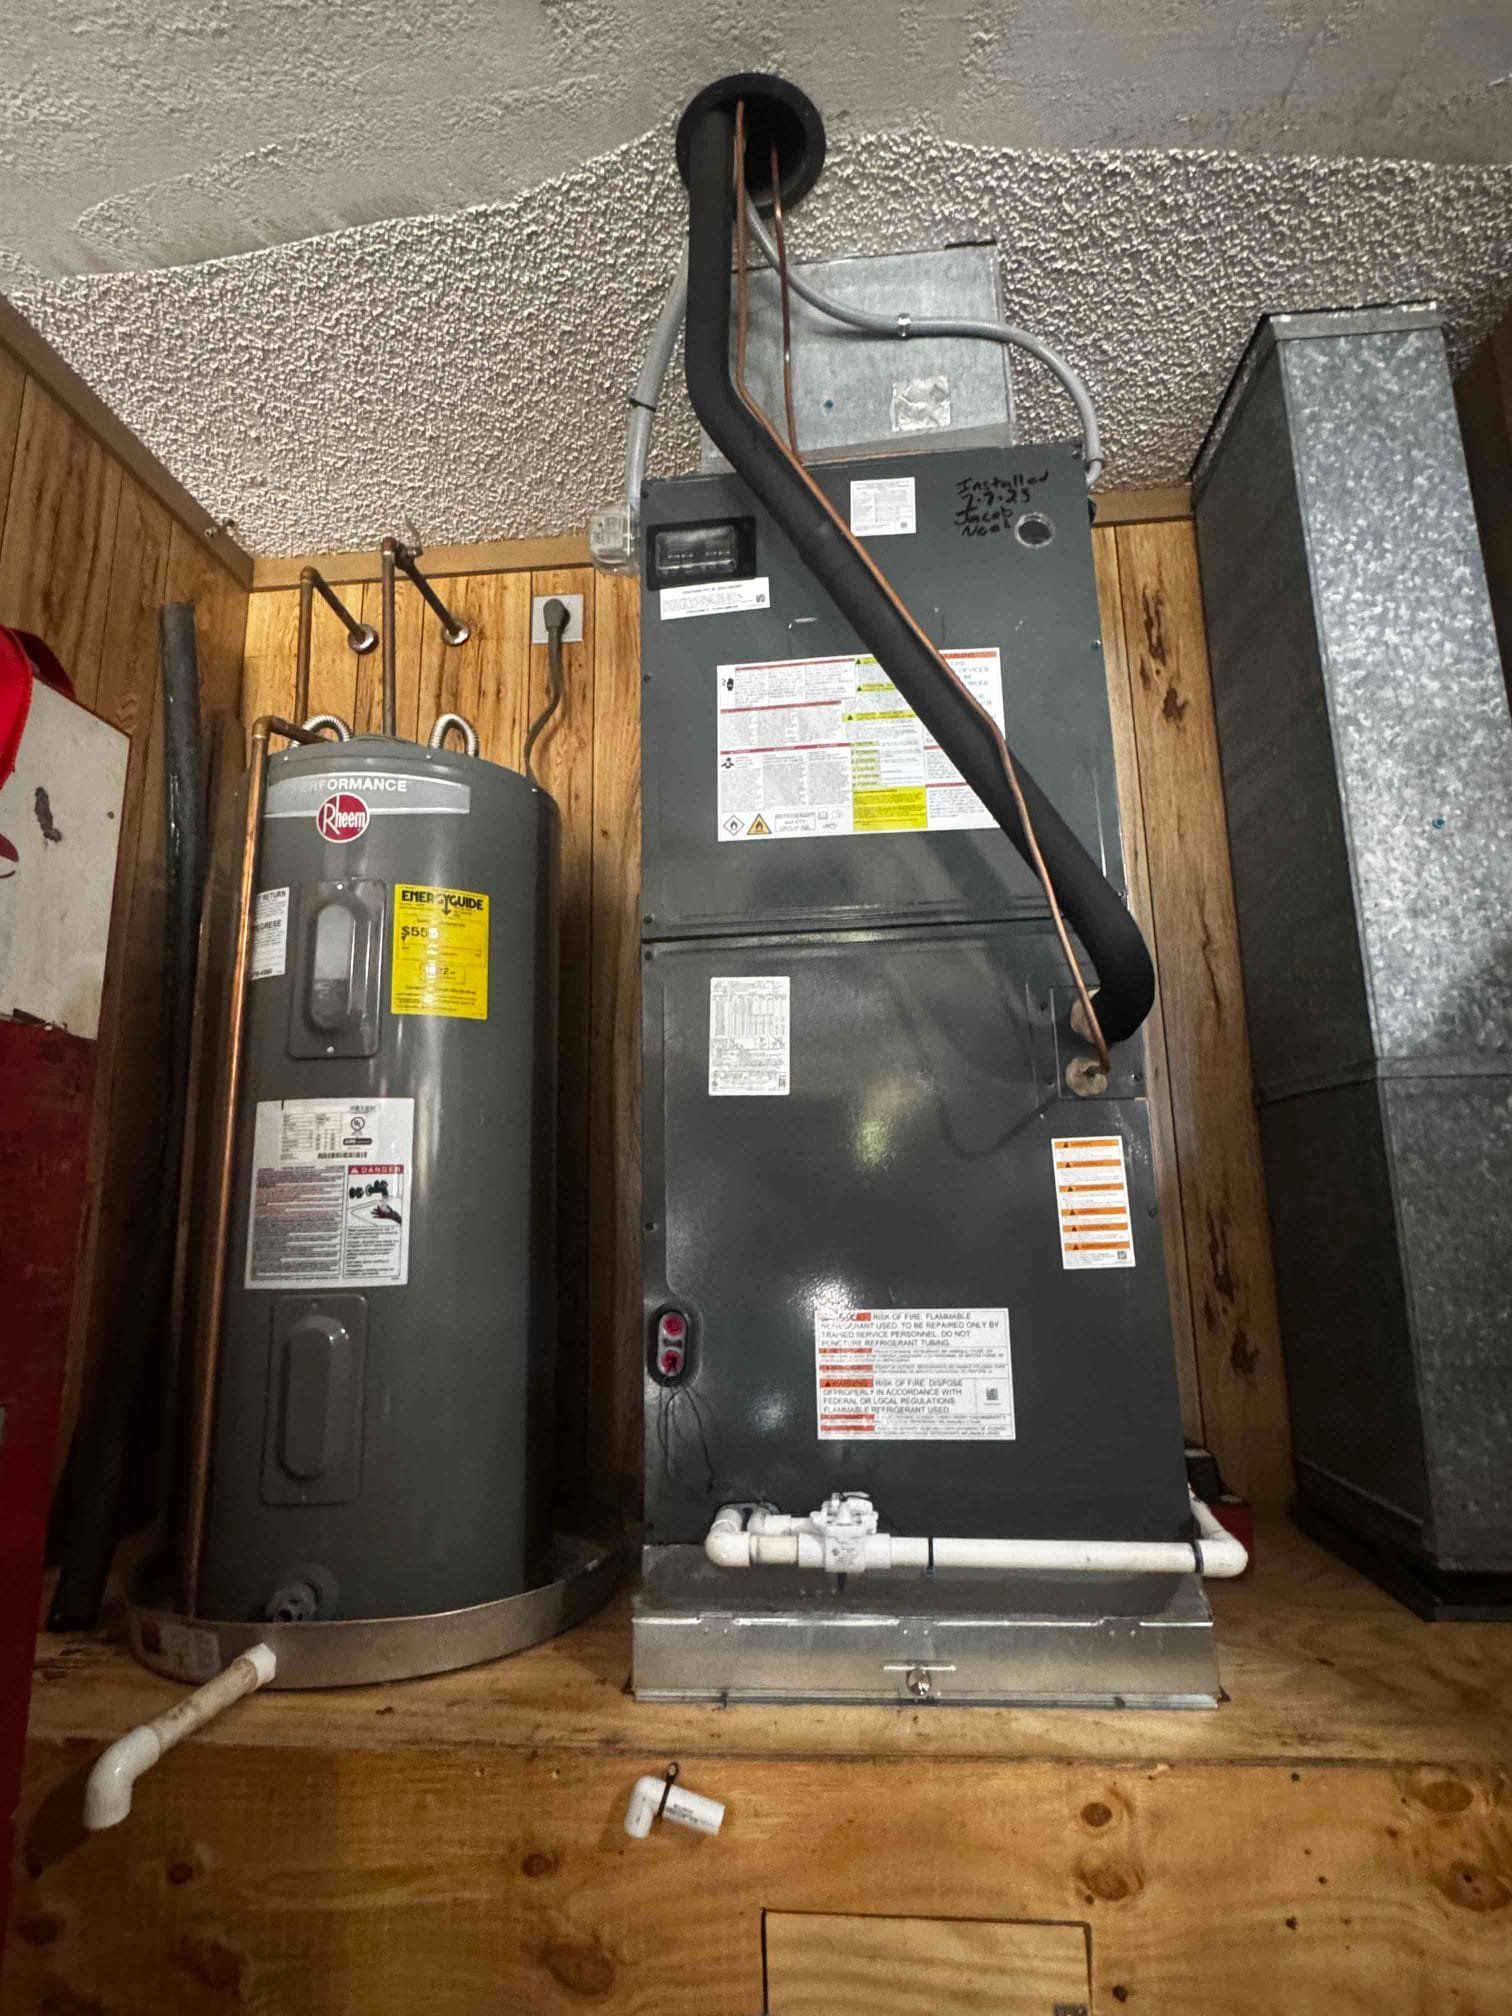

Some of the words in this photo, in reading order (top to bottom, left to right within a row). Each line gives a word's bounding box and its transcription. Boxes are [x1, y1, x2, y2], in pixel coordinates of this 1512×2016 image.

[954, 469, 1049, 494] Installed
[291, 778, 408, 792] ERFORMANCE
[322, 794, 366, 835] Rheem
